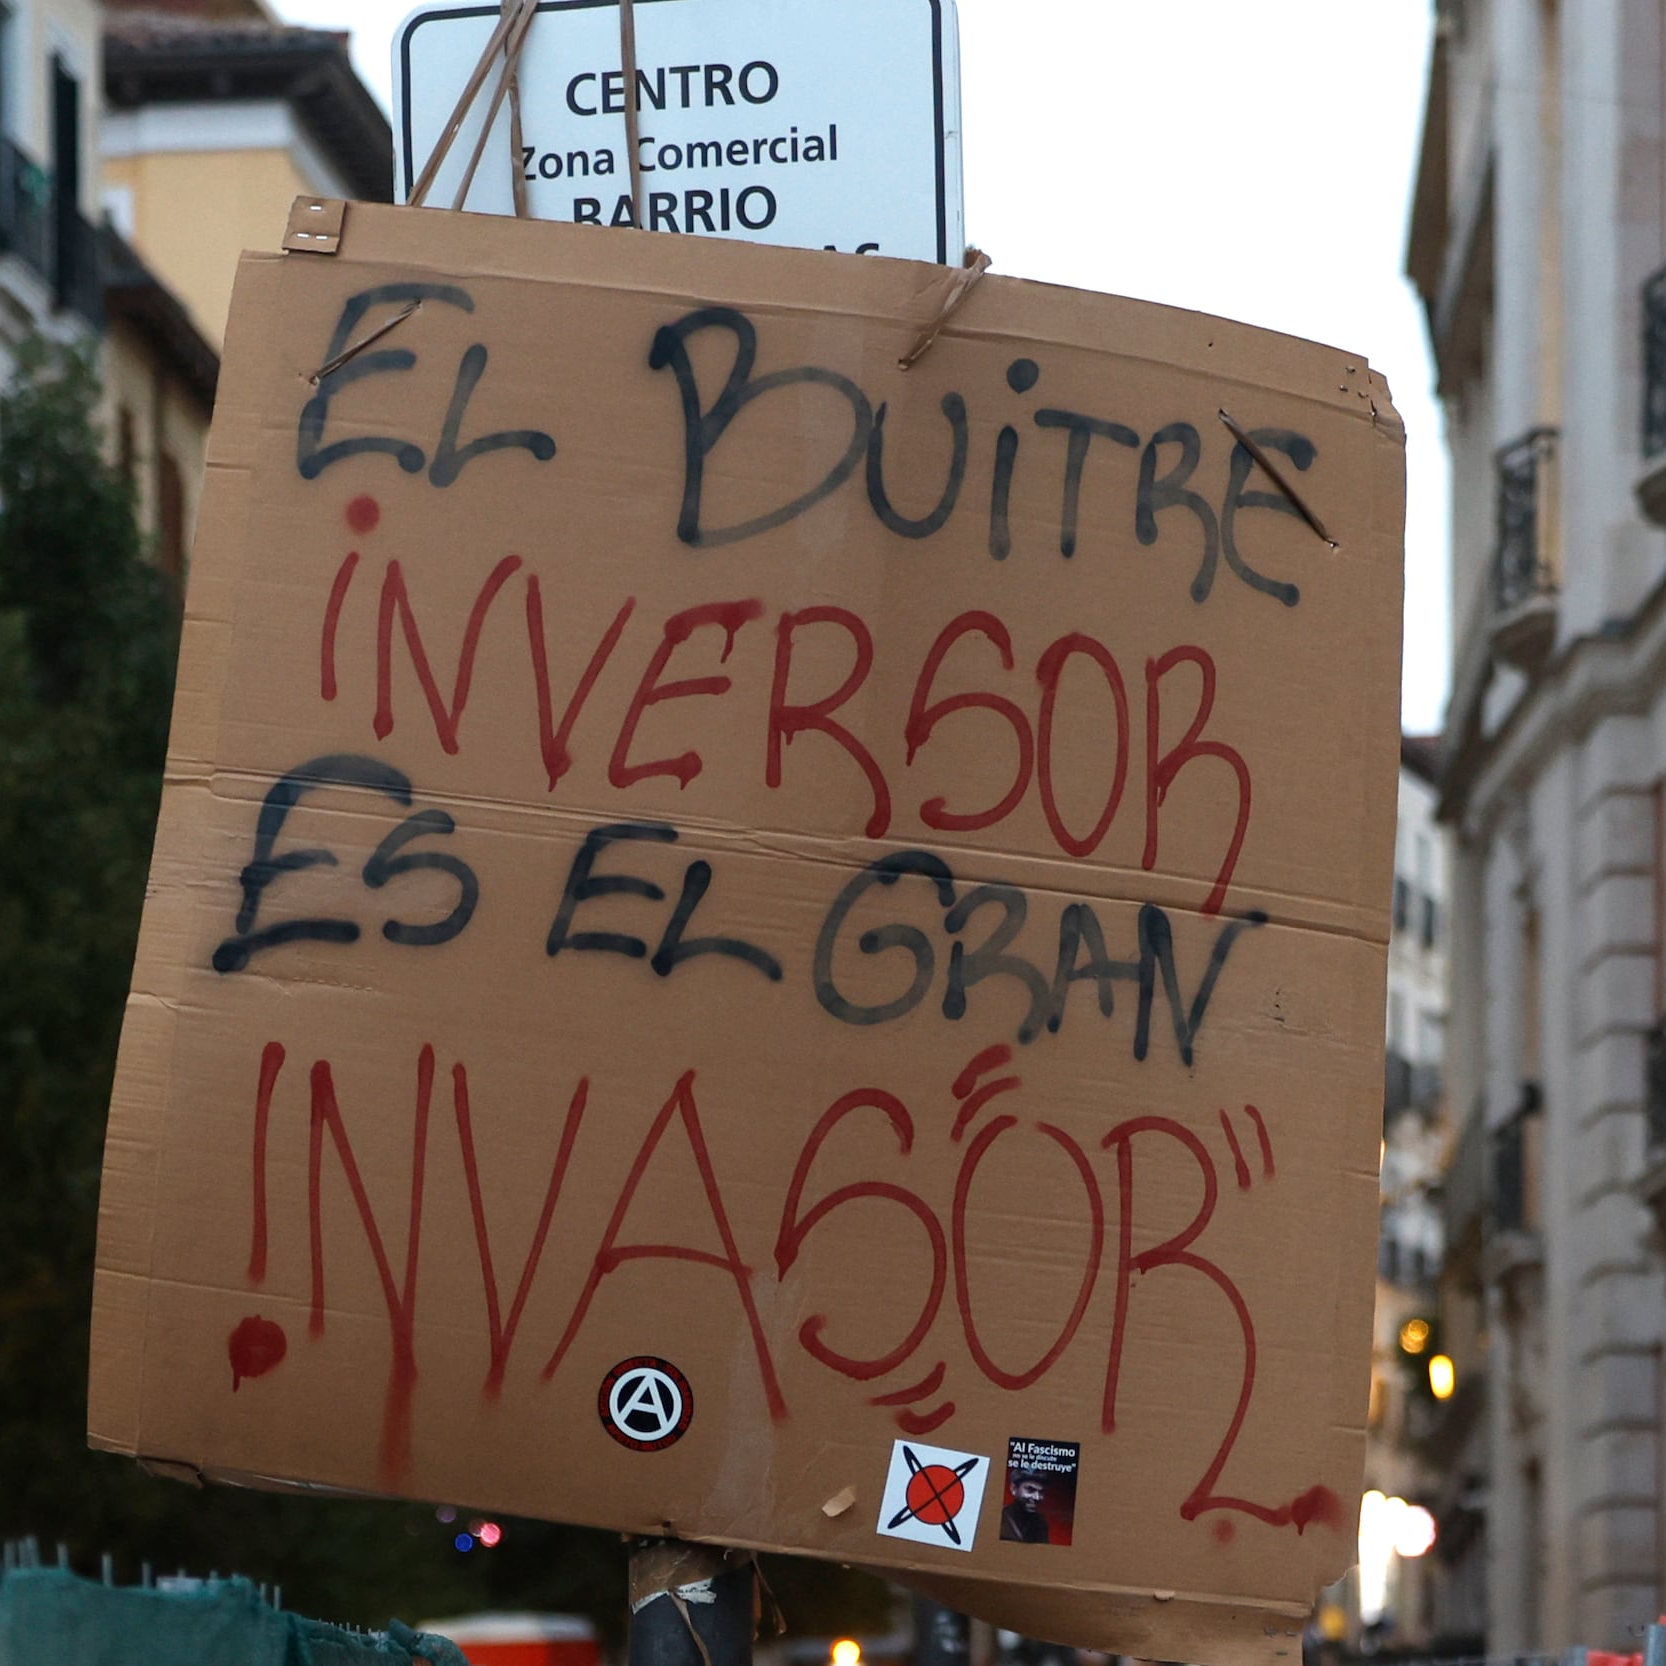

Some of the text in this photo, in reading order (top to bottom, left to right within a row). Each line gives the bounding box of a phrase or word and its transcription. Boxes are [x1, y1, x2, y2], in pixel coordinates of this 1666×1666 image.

[566, 61, 779, 116] CENTRO
[637, 124, 838, 172] Comercial
[296, 283, 556, 487] EL
[212, 755, 1269, 1066] ES EL GRAN
[1008, 1460, 1019, 1468] se
[1021, 1459, 1030, 1469] le
[1028, 1443, 1076, 1457] Fascismo
